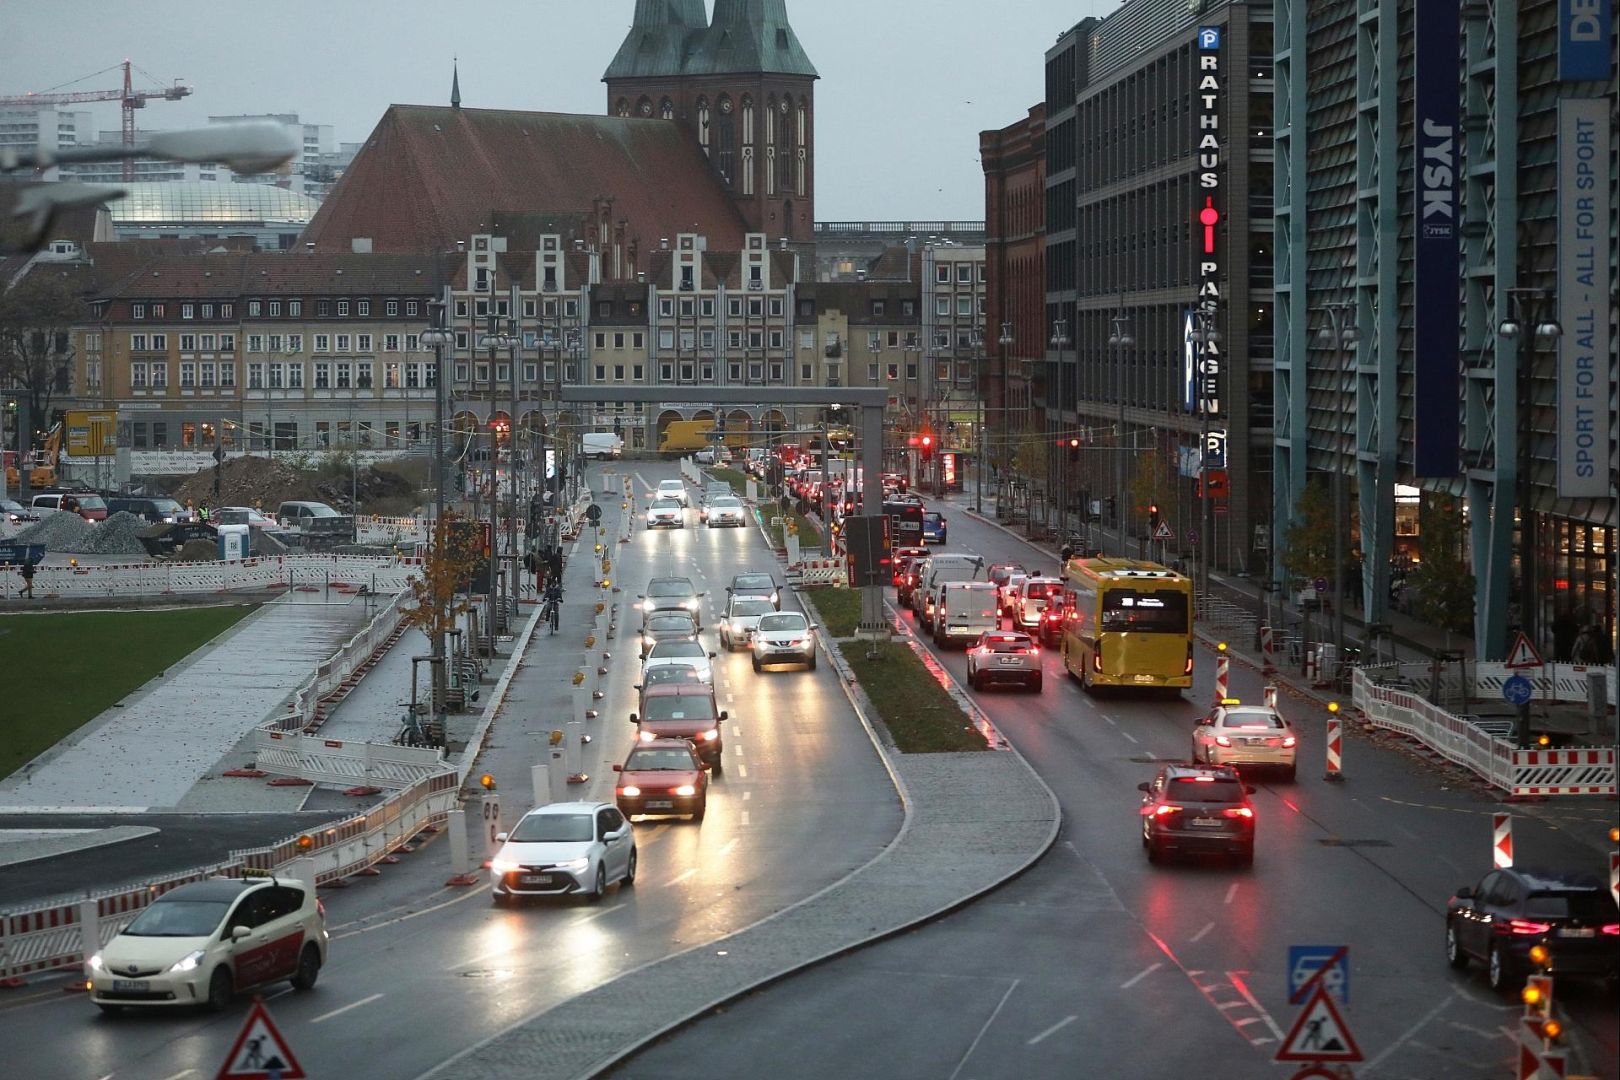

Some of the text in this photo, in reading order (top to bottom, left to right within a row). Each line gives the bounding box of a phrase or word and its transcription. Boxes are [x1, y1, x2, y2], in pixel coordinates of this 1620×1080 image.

[1203, 33, 1216, 48] P
[1570, 0, 1601, 42] DE
[1199, 55, 1219, 188] RATHAUS
[1422, 118, 1453, 219] JYSK
[1576, 117, 1594, 190] SPORT
[1576, 198, 1594, 240] FOR
[1576, 246, 1594, 287] ALL
[1199, 261, 1219, 414] PASAGEN
[1576, 309, 1594, 350] ALL
[1576, 356, 1594, 398] FOR
[1576, 405, 1594, 478] SPORT
